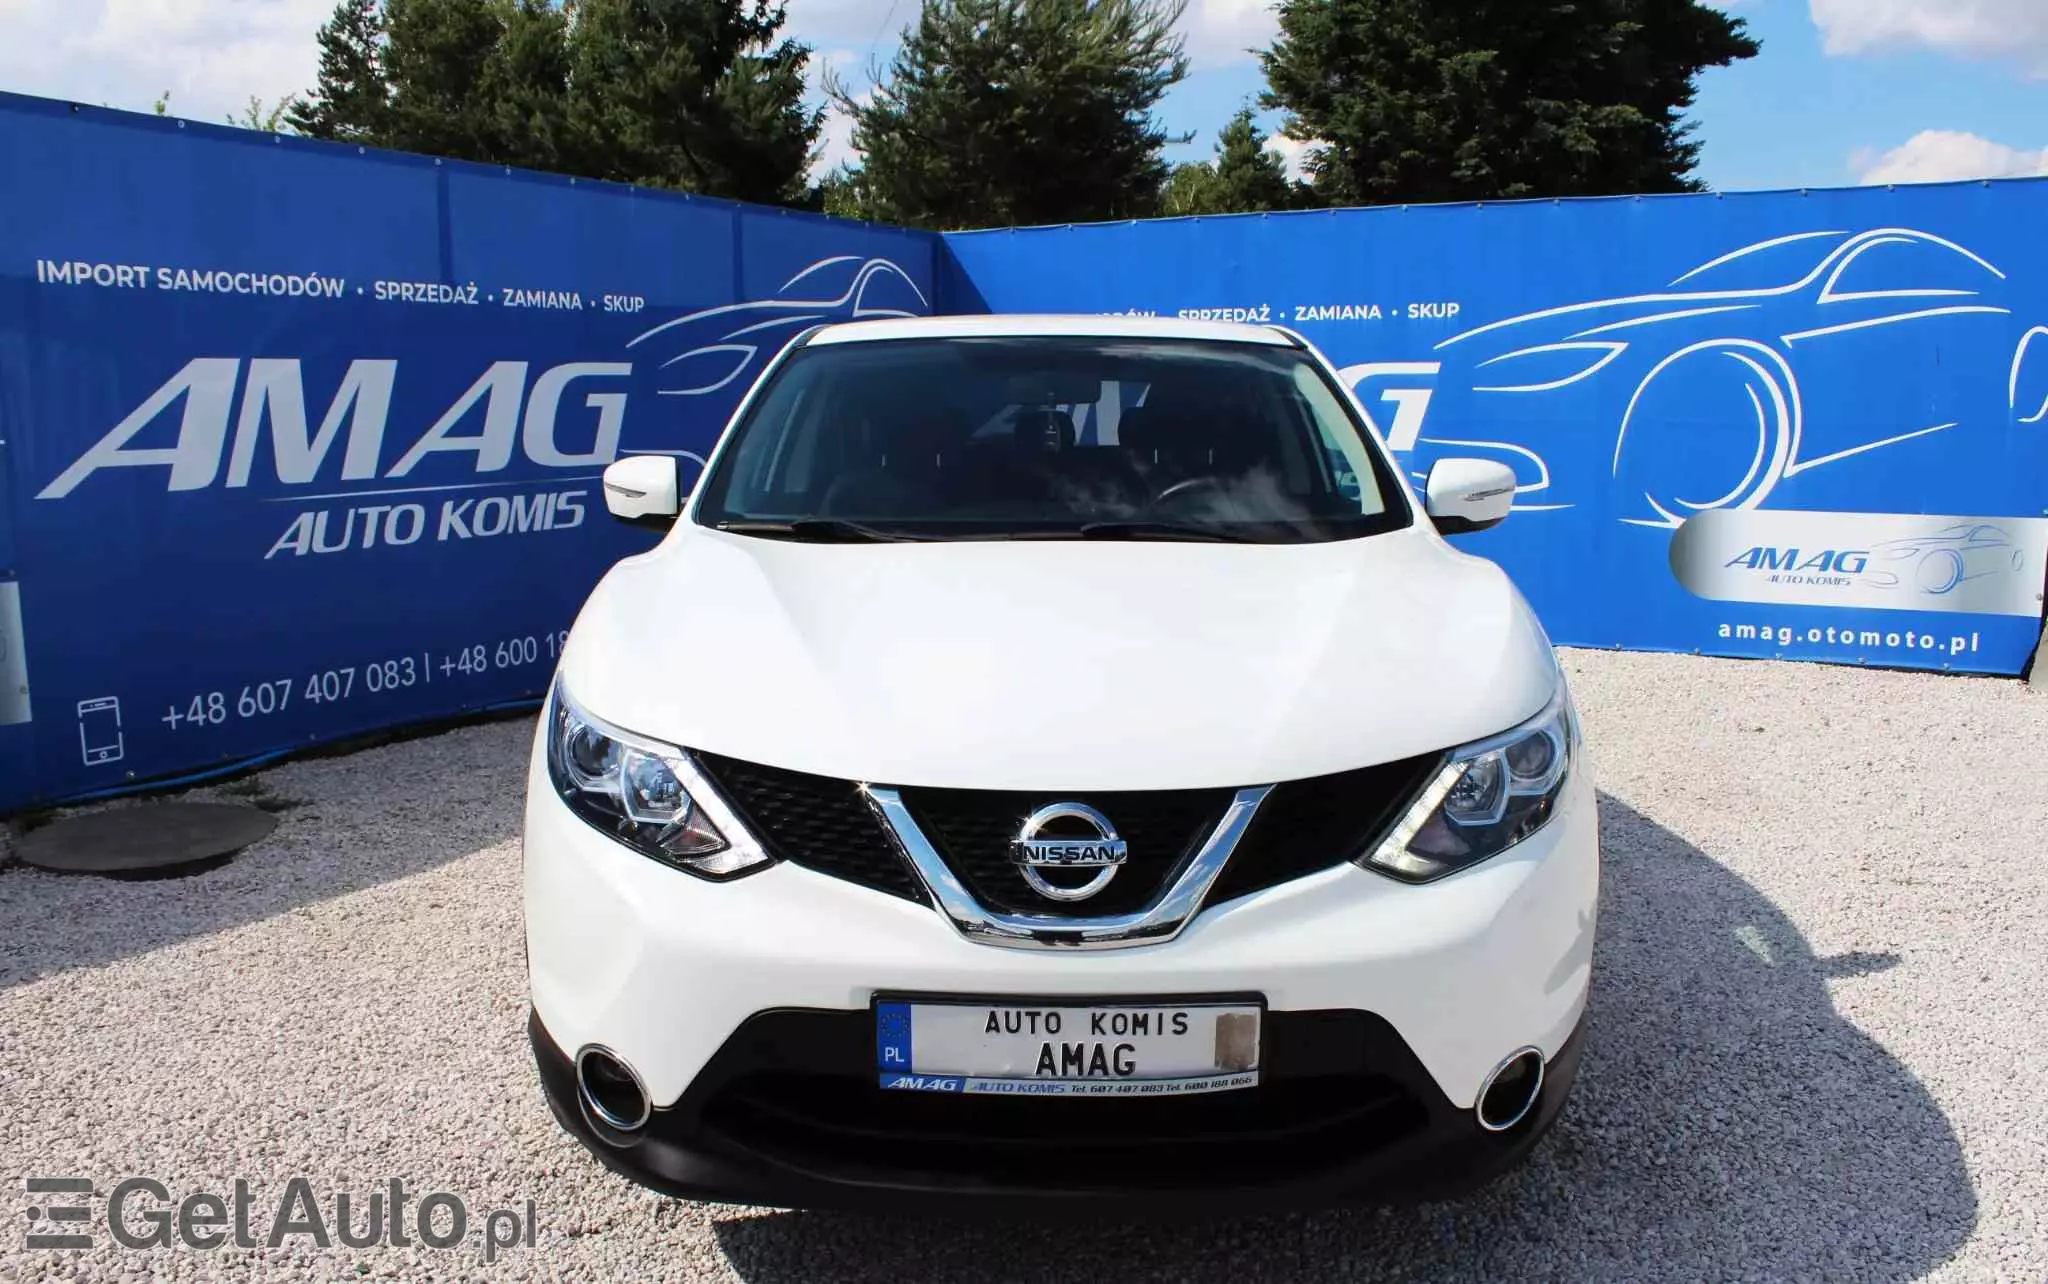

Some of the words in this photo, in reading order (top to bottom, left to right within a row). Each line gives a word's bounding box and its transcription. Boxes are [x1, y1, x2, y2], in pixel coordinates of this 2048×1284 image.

[36, 259, 150, 288] IMPORT
[157, 267, 345, 298] SAMOCHODÓW
[374, 280, 479, 305] SPRZEDAŻ
[502, 288, 583, 310] ZAMIANA
[603, 294, 645, 313] SKUP
[1178, 303, 1271, 322] SPRZEDAŻ
[1294, 304, 1382, 322] ZAMIANA
[1407, 303, 1460, 319] SKUP
[264, 502, 426, 560] AUTO
[439, 490, 589, 545] KOMIS
[1723, 547, 1870, 574] AMAG
[1765, 574, 1802, 584] AUTO
[1806, 576, 1851, 586] KOMIS
[1718, 623, 1979, 655] amag.otomoto.pl
[161, 692, 226, 731] +48
[237, 680, 291, 717] 607
[304, 667, 356, 703] 407
[366, 657, 417, 693] 083
[440, 644, 488, 678] +48
[495, 635, 537, 668] 600
[1023, 845, 1116, 860] NISSAN
[984, 1011, 1061, 1034] AUTO
[1091, 1012, 1189, 1035] KOMIS
[885, 1048, 904, 1063] PL
[1035, 1043, 1136, 1077] AMAG
[972, 1081, 1013, 1092] AUTO
[1017, 1083, 1065, 1094] KOMIS
[1090, 1085, 1112, 1093] 607
[1115, 1085, 1138, 1093] 407
[1184, 1081, 1208, 1091] 600
